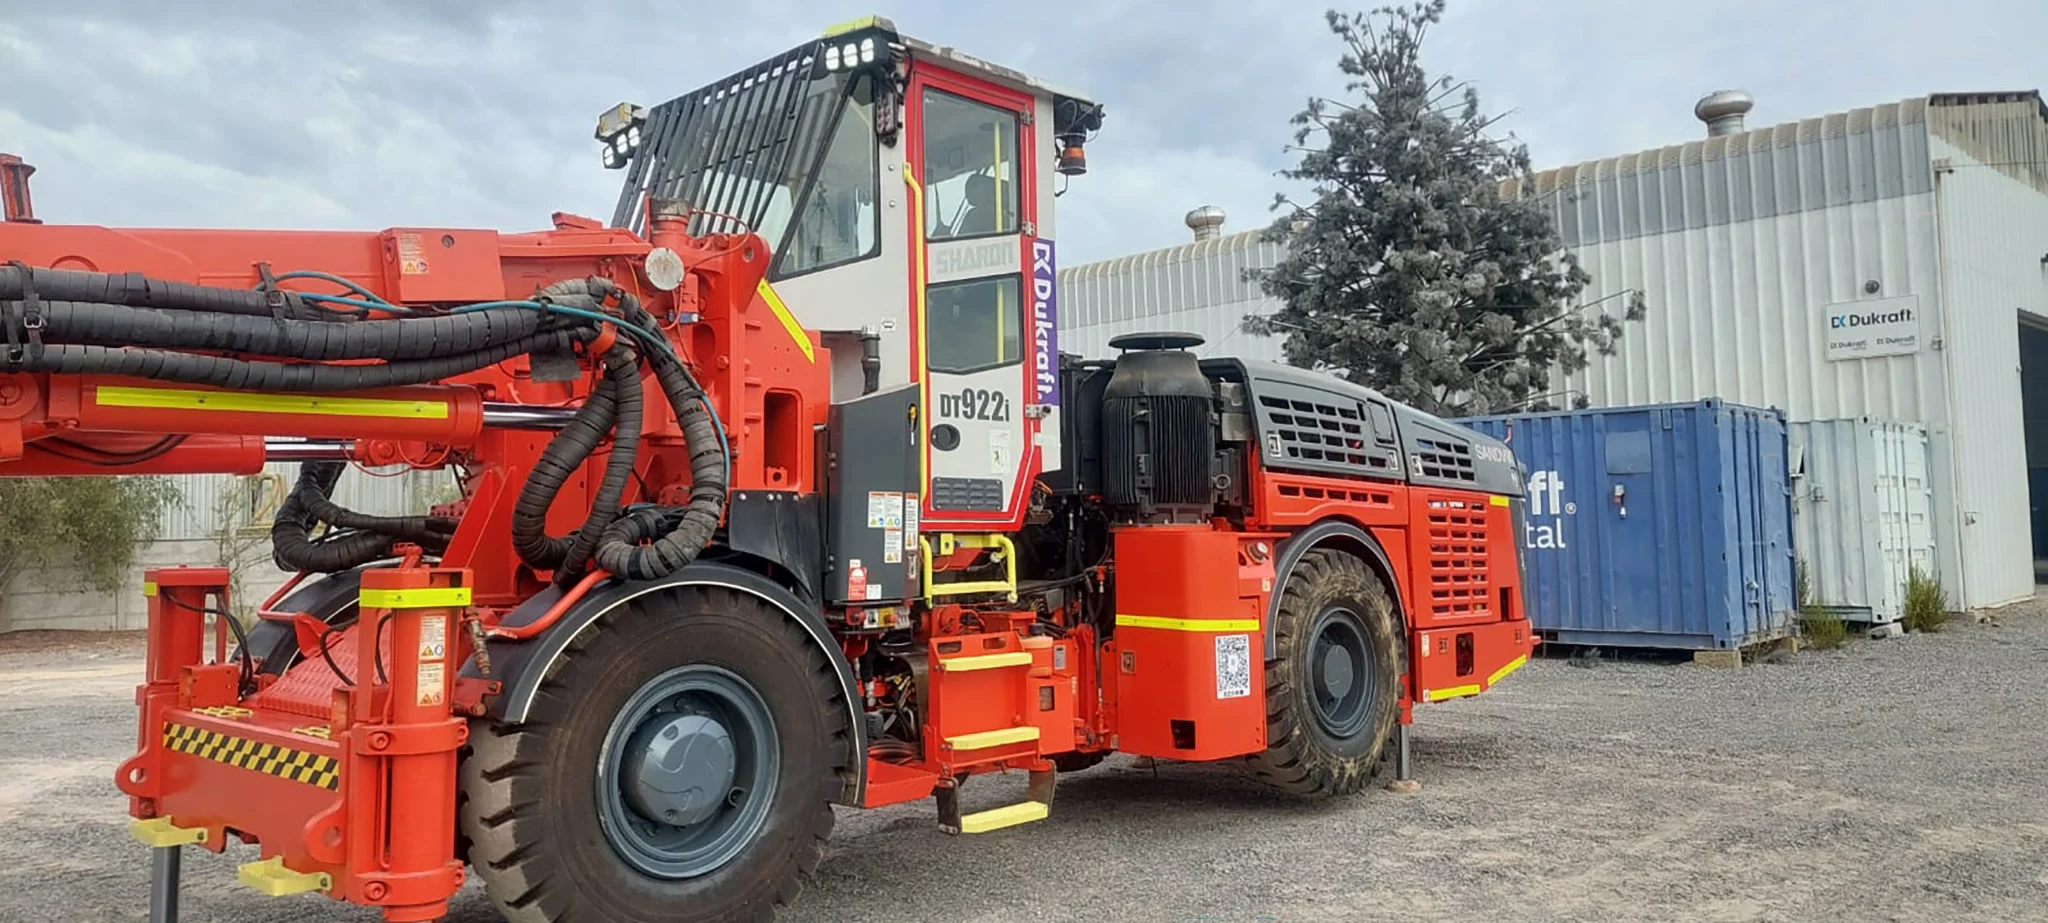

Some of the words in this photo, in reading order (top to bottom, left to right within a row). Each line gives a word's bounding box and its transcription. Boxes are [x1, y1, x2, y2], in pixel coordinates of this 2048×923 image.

[936, 241, 1013, 274] SHARON
[940, 388, 1010, 422] DT922i
[1526, 518, 1566, 549] tal
